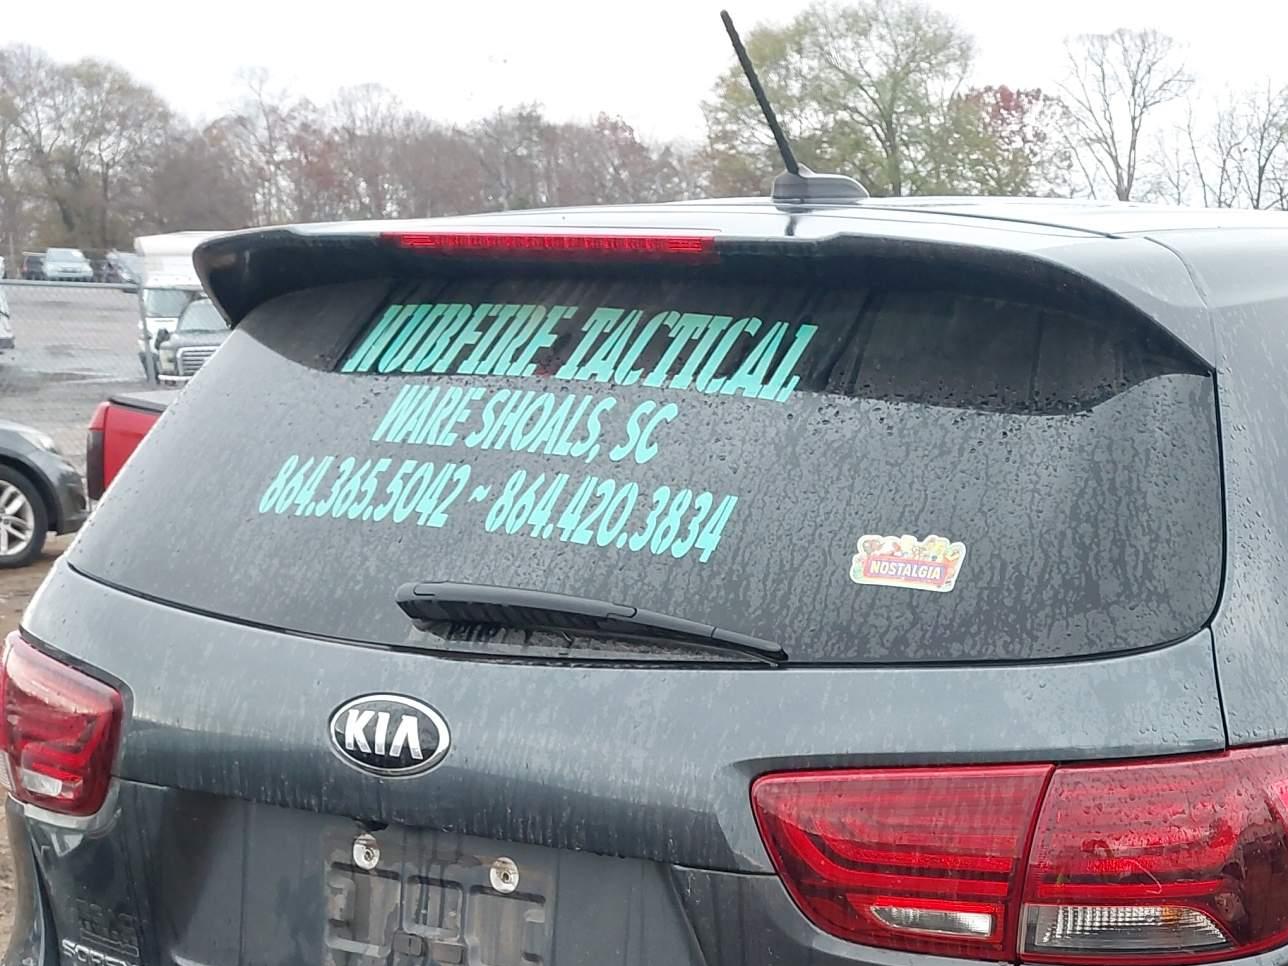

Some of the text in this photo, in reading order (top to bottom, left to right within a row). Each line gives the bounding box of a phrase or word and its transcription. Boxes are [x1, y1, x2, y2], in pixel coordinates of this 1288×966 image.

[554, 306, 819, 403] TACTICAL
[371, 385, 680, 465] WARE SHOALS, SC
[260, 455, 473, 528] 864.365.5042
[486, 470, 739, 563] 864.420.3834
[870, 560, 941, 580] NOSTALGIA
[344, 708, 424, 760] KIA
